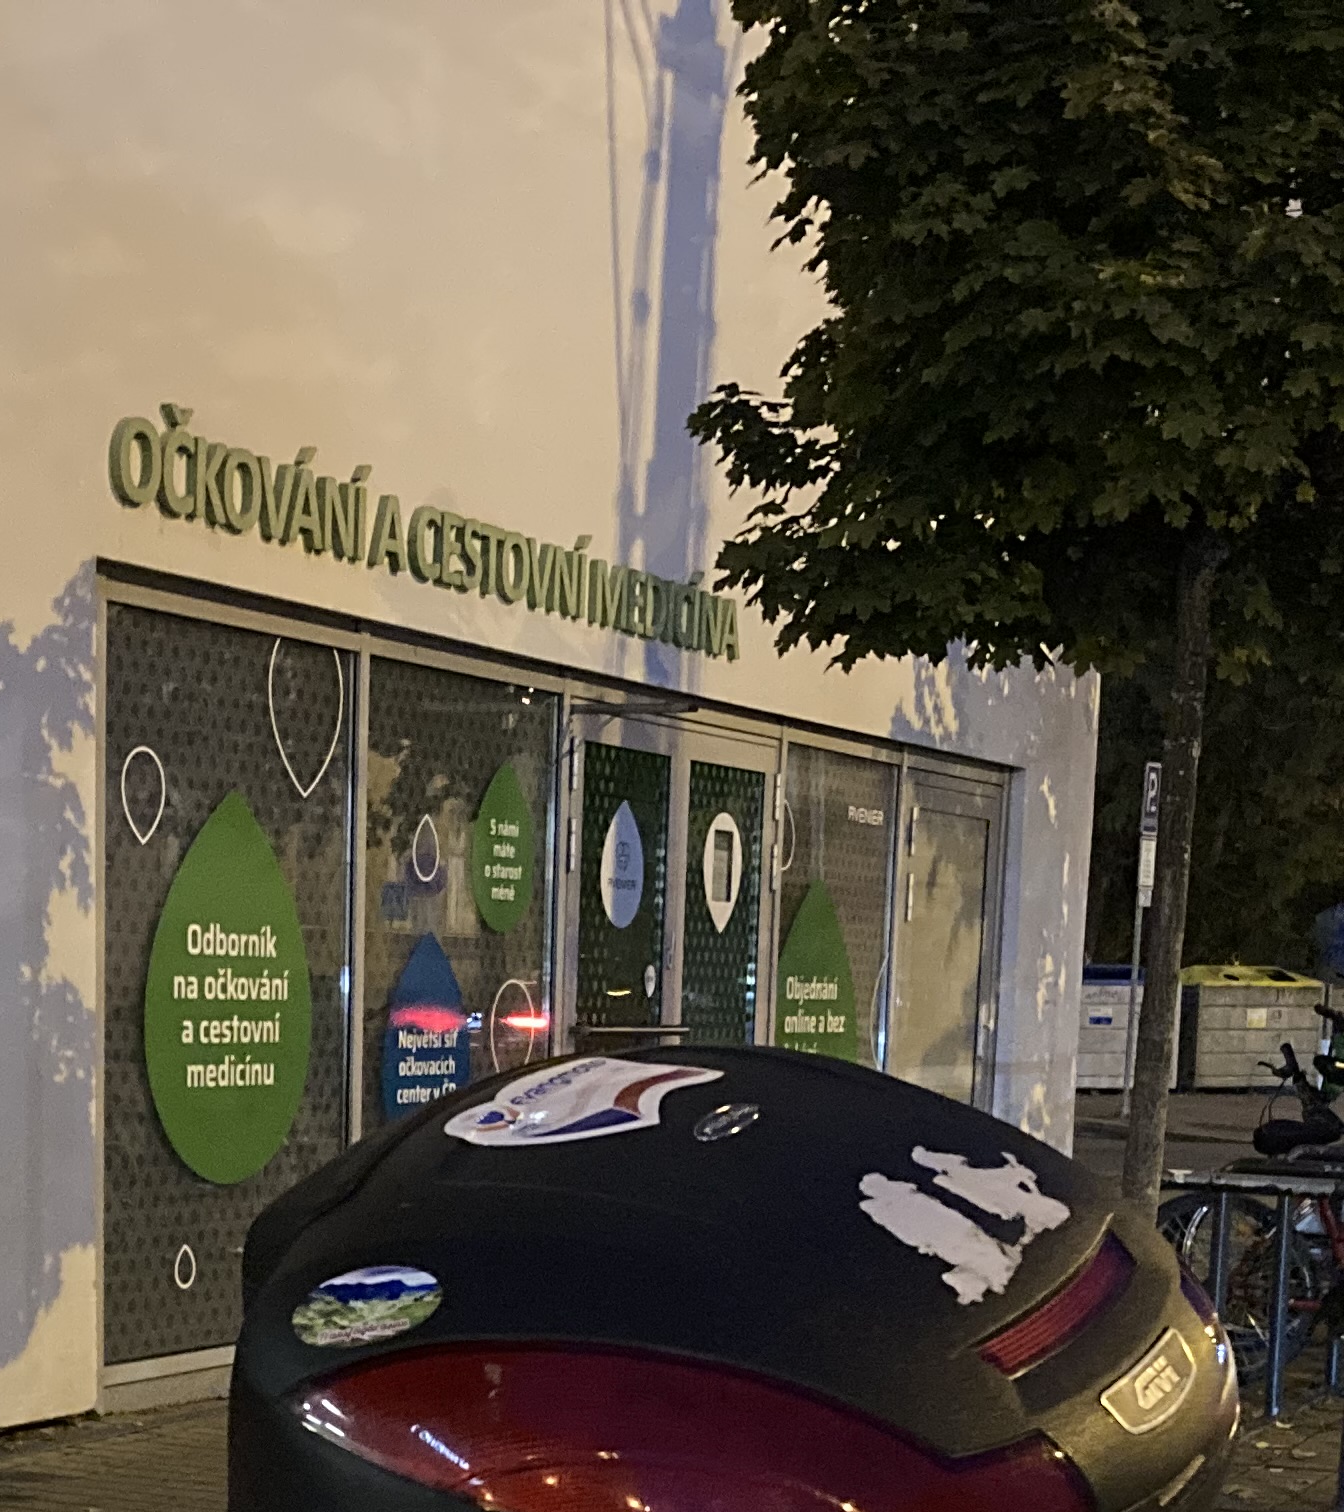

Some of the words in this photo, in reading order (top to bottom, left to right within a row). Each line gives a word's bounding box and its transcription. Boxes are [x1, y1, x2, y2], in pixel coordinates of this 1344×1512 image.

[108, 403, 372, 563] OČKOVÁNÍ
[367, 494, 407, 575] A
[407, 503, 593, 620] CESTOVNÍ
[587, 557, 742, 661] MEDICÍNA
[490, 818, 497, 836] S
[497, 820, 520, 837] námi
[484, 864, 492, 878] o
[187, 922, 278, 958] Odborník
[173, 975, 199, 1000] na
[204, 967, 290, 1001] očkování
[786, 975, 839, 1006] Objednání
[181, 1019, 194, 1044] a
[199, 1012, 281, 1044] cestovní
[784, 1008, 817, 1034] online
[818, 1015, 826, 1034] a
[826, 1008, 846, 1034] bez
[186, 1054, 275, 1088] medicínu
[398, 1055, 456, 1077] očkovacích
[397, 1084, 432, 1105] center
[433, 1086, 441, 1100] v
[1134, 1355, 1181, 1410] GIVI
